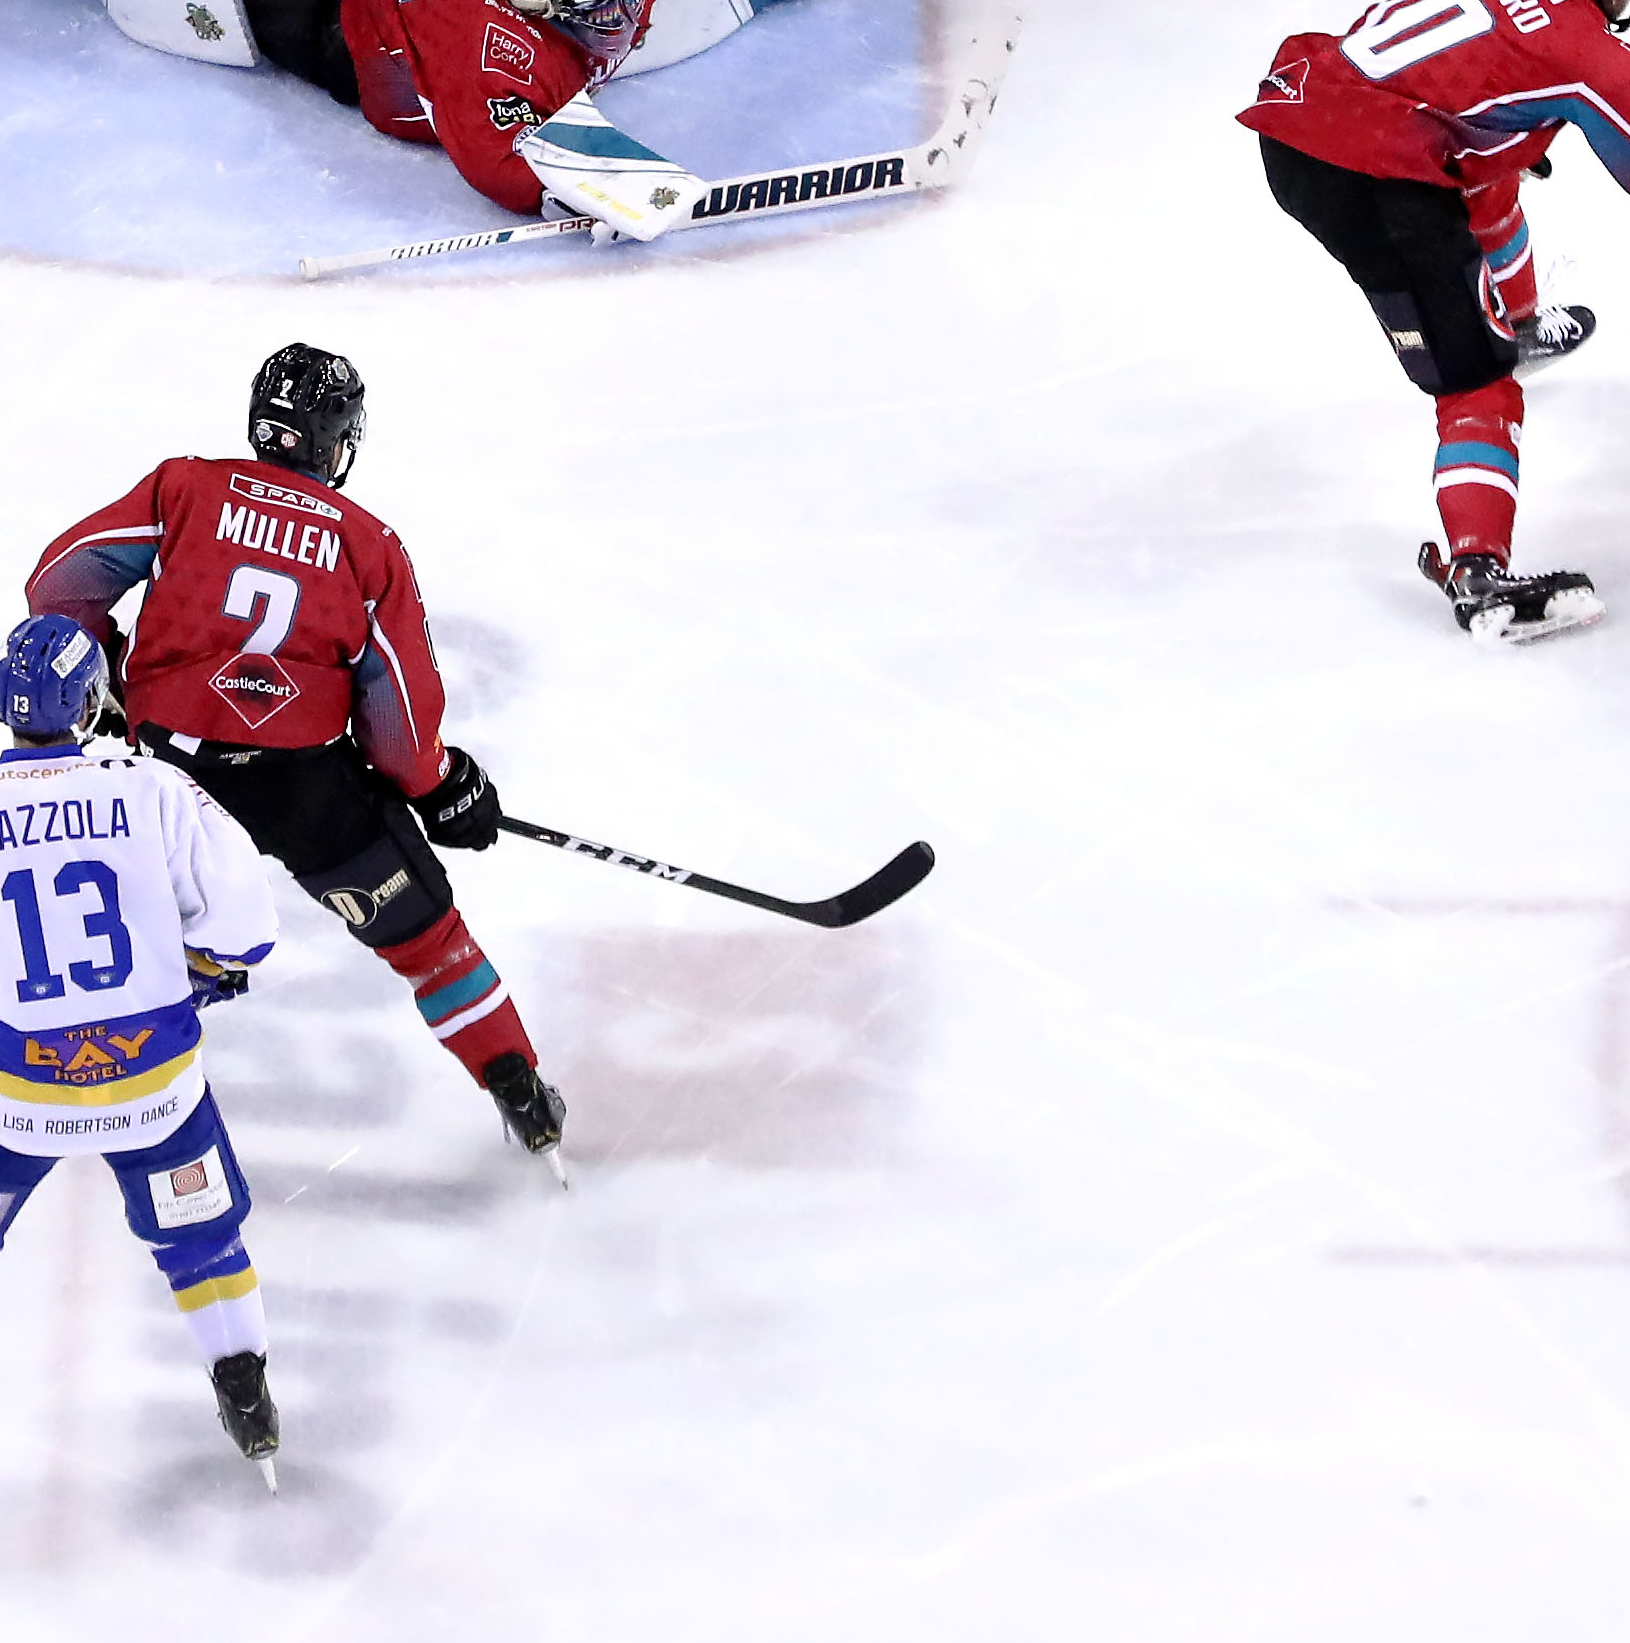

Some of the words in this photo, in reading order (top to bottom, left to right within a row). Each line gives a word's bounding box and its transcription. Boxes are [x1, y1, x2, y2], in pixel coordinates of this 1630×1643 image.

[491, 31, 529, 63] Harry
[691, 157, 904, 219] WARRIOR
[250, 484, 318, 509] SPAR
[215, 502, 342, 572] MULLEN
[222, 563, 301, 656] 2
[12, 694, 30, 713] 13
[215, 675, 291, 697] CastleCourt
[563, 835, 693, 885] CCM
[0, 860, 133, 1003] 13
[63, 1025, 107, 1042] THE
[54, 1063, 128, 1084] HOTEL
[2, 1113, 35, 1133] LISA
[45, 1115, 131, 1135] ROBERTSON
[140, 1096, 179, 1126] DANCE
